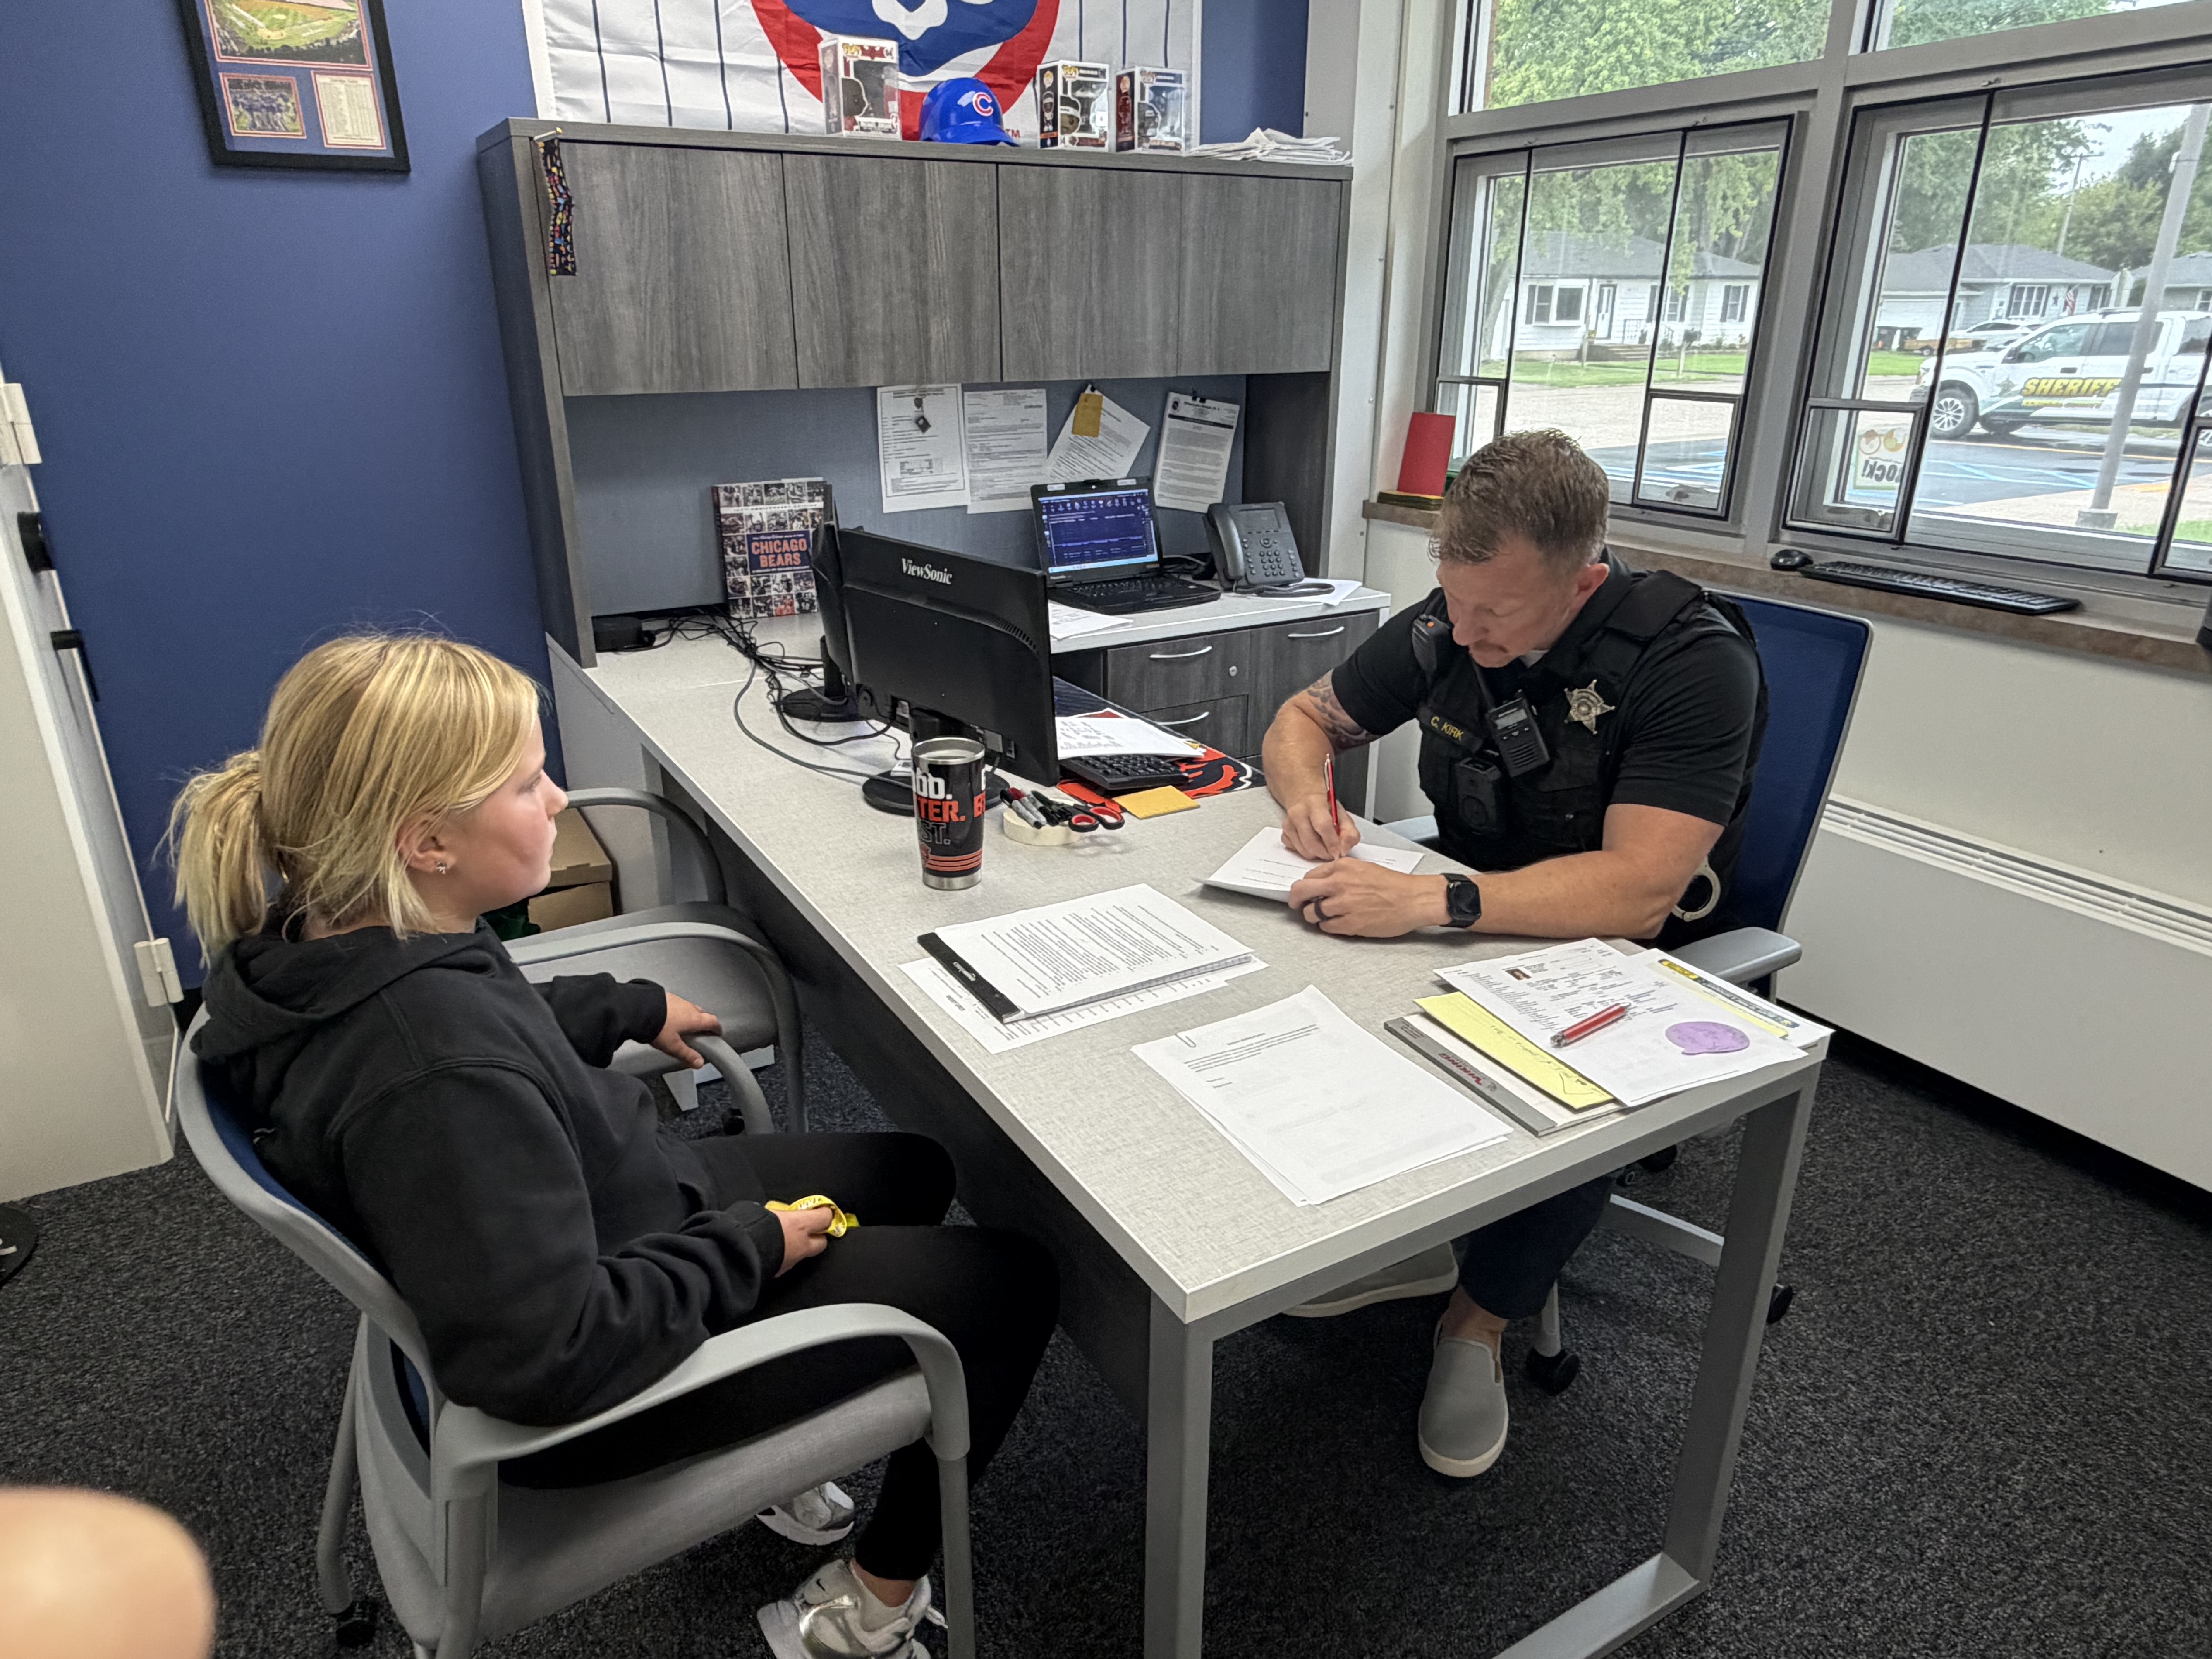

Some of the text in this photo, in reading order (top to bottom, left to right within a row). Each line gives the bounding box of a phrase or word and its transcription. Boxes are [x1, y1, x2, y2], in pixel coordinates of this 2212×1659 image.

[972, 92, 994, 116] C
[2022, 378, 2122, 396] SHERIFF
[752, 538, 807, 555] CHICAGO
[760, 553, 801, 568] BEARS
[902, 558, 953, 584] ViewSonic
[1441, 722, 1464, 741] KIRK
[913, 771, 952, 799] OD.
[1438, 1053, 1482, 1086] VIKING
